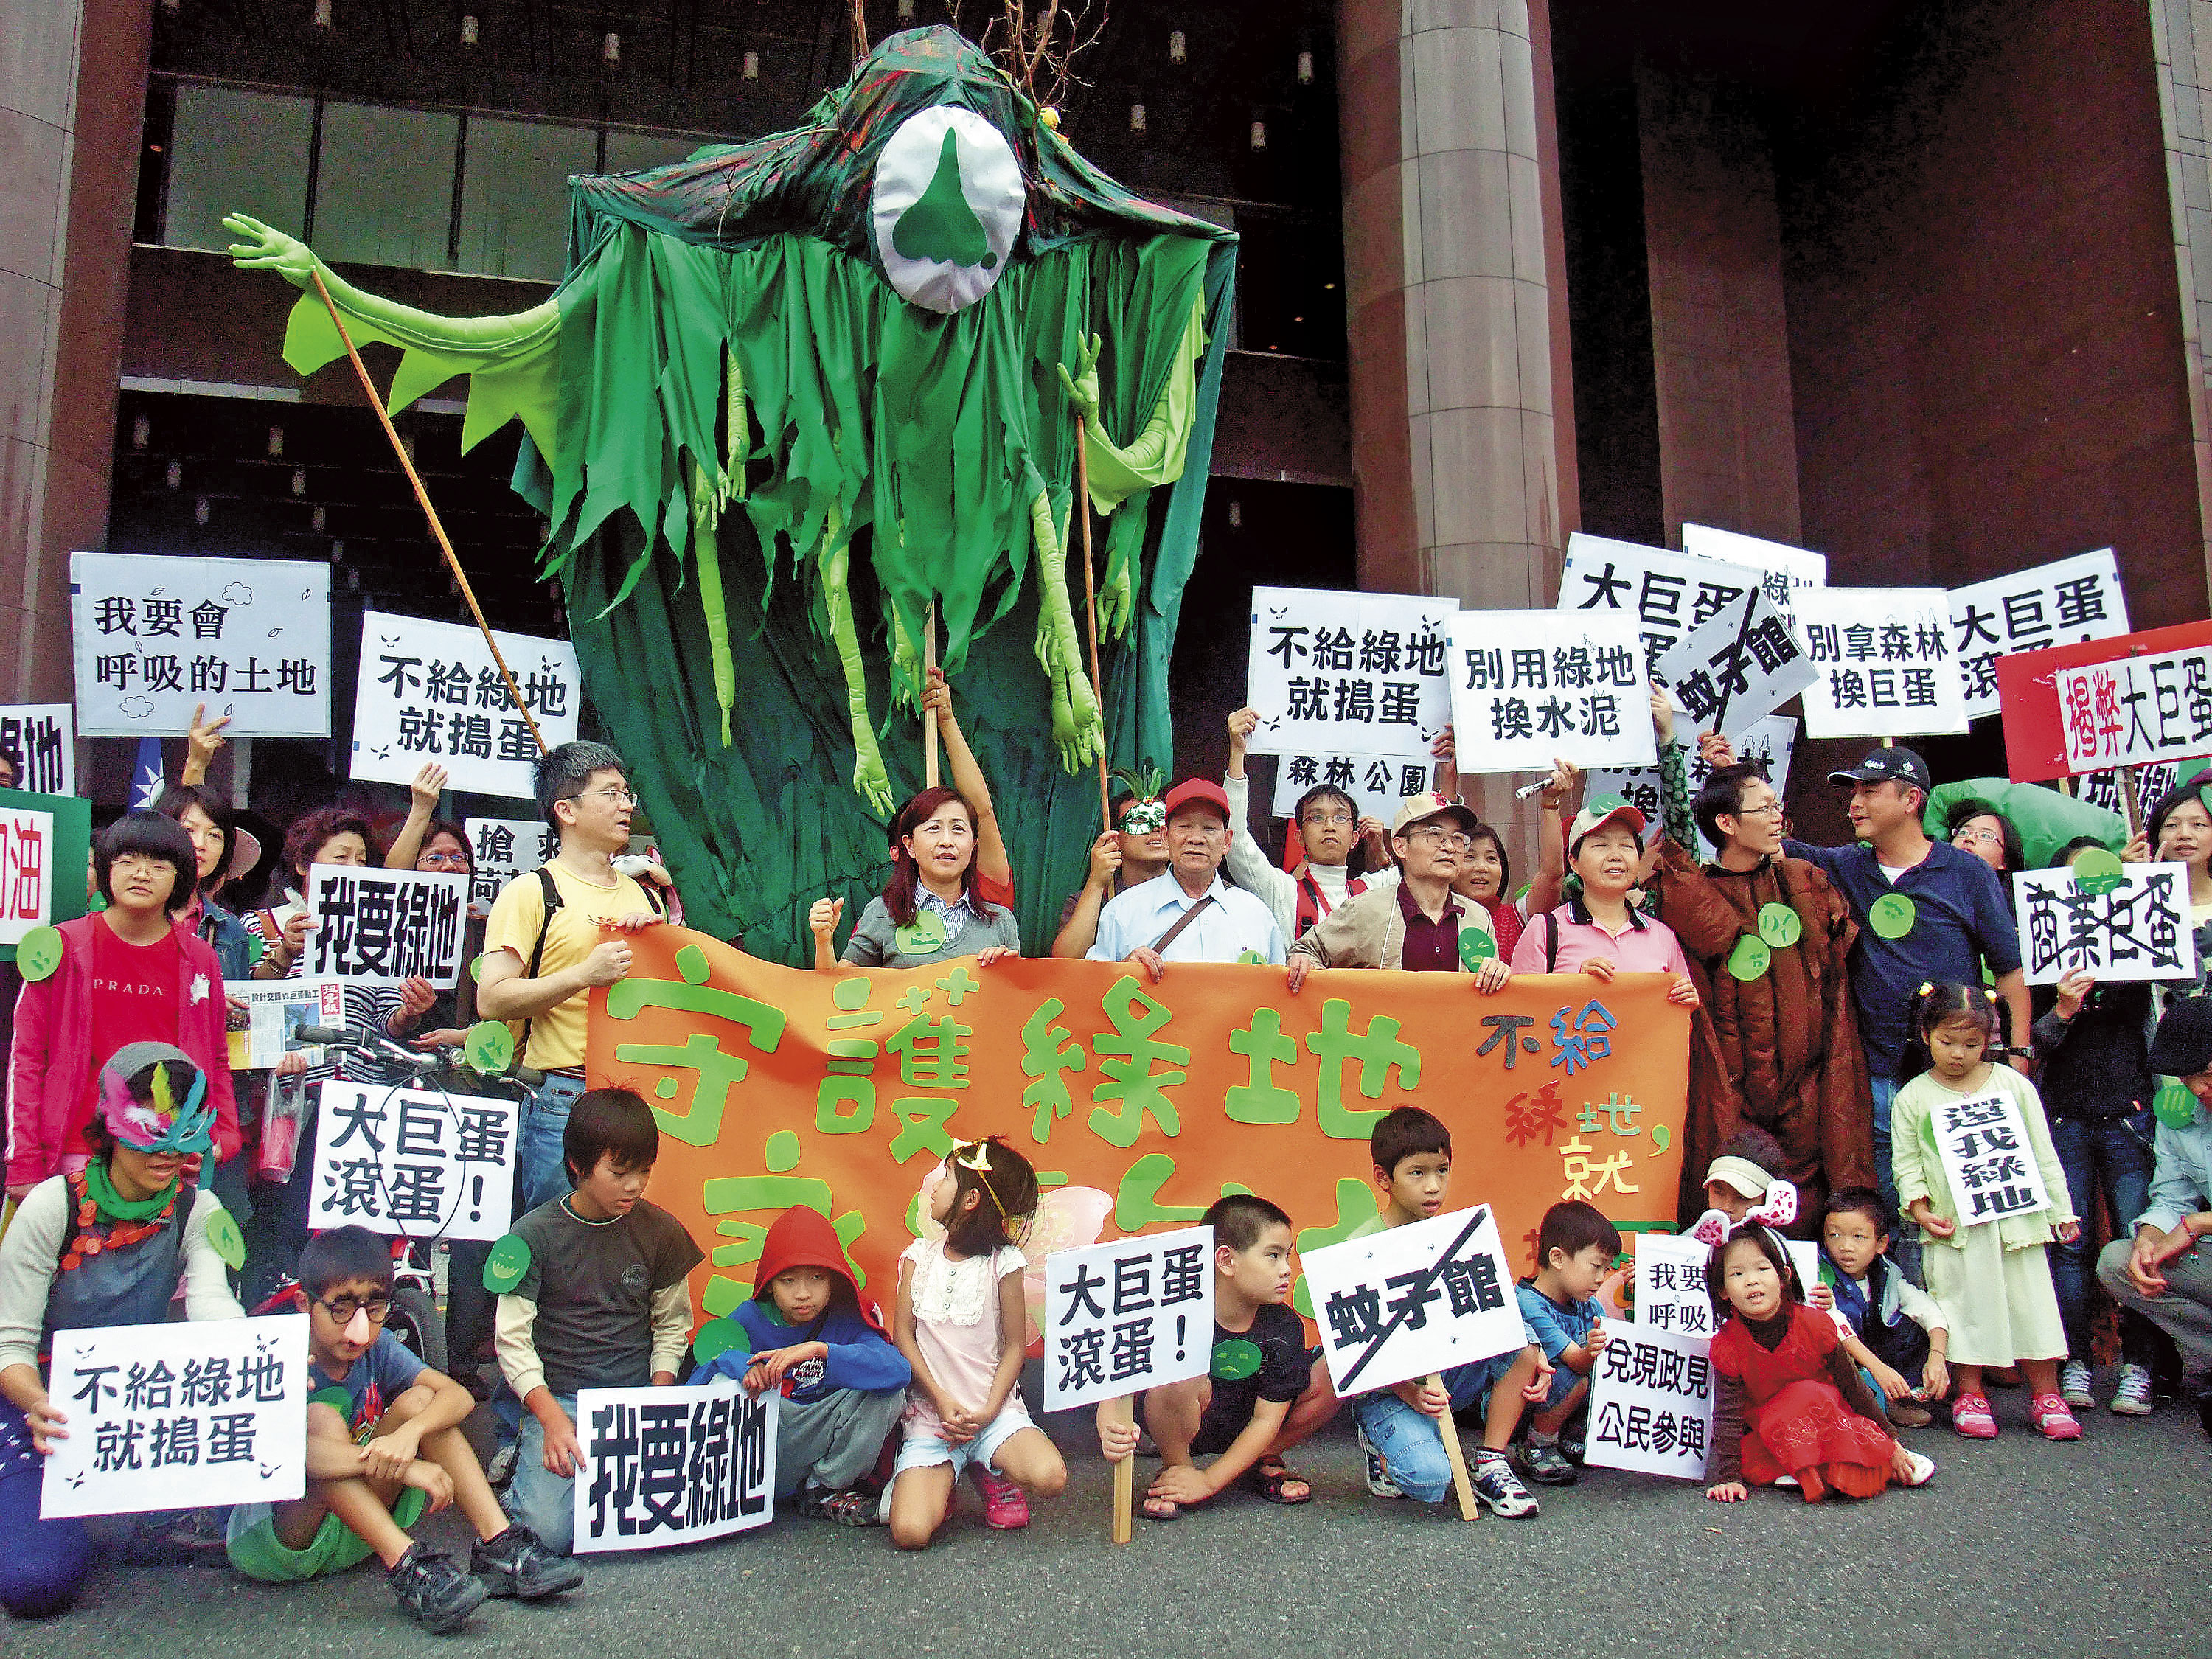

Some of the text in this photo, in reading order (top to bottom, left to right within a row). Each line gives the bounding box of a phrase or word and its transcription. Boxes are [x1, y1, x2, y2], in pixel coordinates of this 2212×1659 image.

[94, 594, 229, 639] 我要會
[1806, 622, 1949, 663] 別拿森林
[1953, 573, 2108, 653] 大巨蛋
[95, 653, 317, 696] 呼吸的土地
[1267, 625, 1445, 678] 不給綠地
[1464, 645, 1637, 691] 別用綠地
[1674, 615, 1801, 725] 蚊子館
[377, 653, 567, 717] 不給綠地
[1286, 675, 1421, 727] 就搗蛋
[1830, 668, 1938, 708] 換巨蛋
[2065, 655, 2212, 761] 揭弊大巨蛋
[398, 708, 542, 762] 就搗蛋
[1490, 694, 1621, 741] 換水泥
[1287, 754, 1427, 797] 森林公園
[315, 876, 460, 979] 我要綠地
[93, 978, 164, 996] PRADA
[606, 944, 1422, 1166] 守護綠地
[1475, 998, 1618, 1076] 不給
[330, 1091, 510, 1166] 大巨蛋
[1941, 1097, 2038, 1217] 還我綠地
[1559, 1135, 1639, 1200] 就
[1058, 1242, 1205, 1326] 大巨蛋
[1325, 1251, 1506, 1352] 蚊子館
[72, 1352, 287, 1415] 不給綠地
[1601, 1338, 1709, 1399] 兌現政見
[93, 1412, 257, 1472] 就搗蛋
[1596, 1401, 1705, 1461] 公民參與
[589, 1394, 768, 1539] 我要綠地
